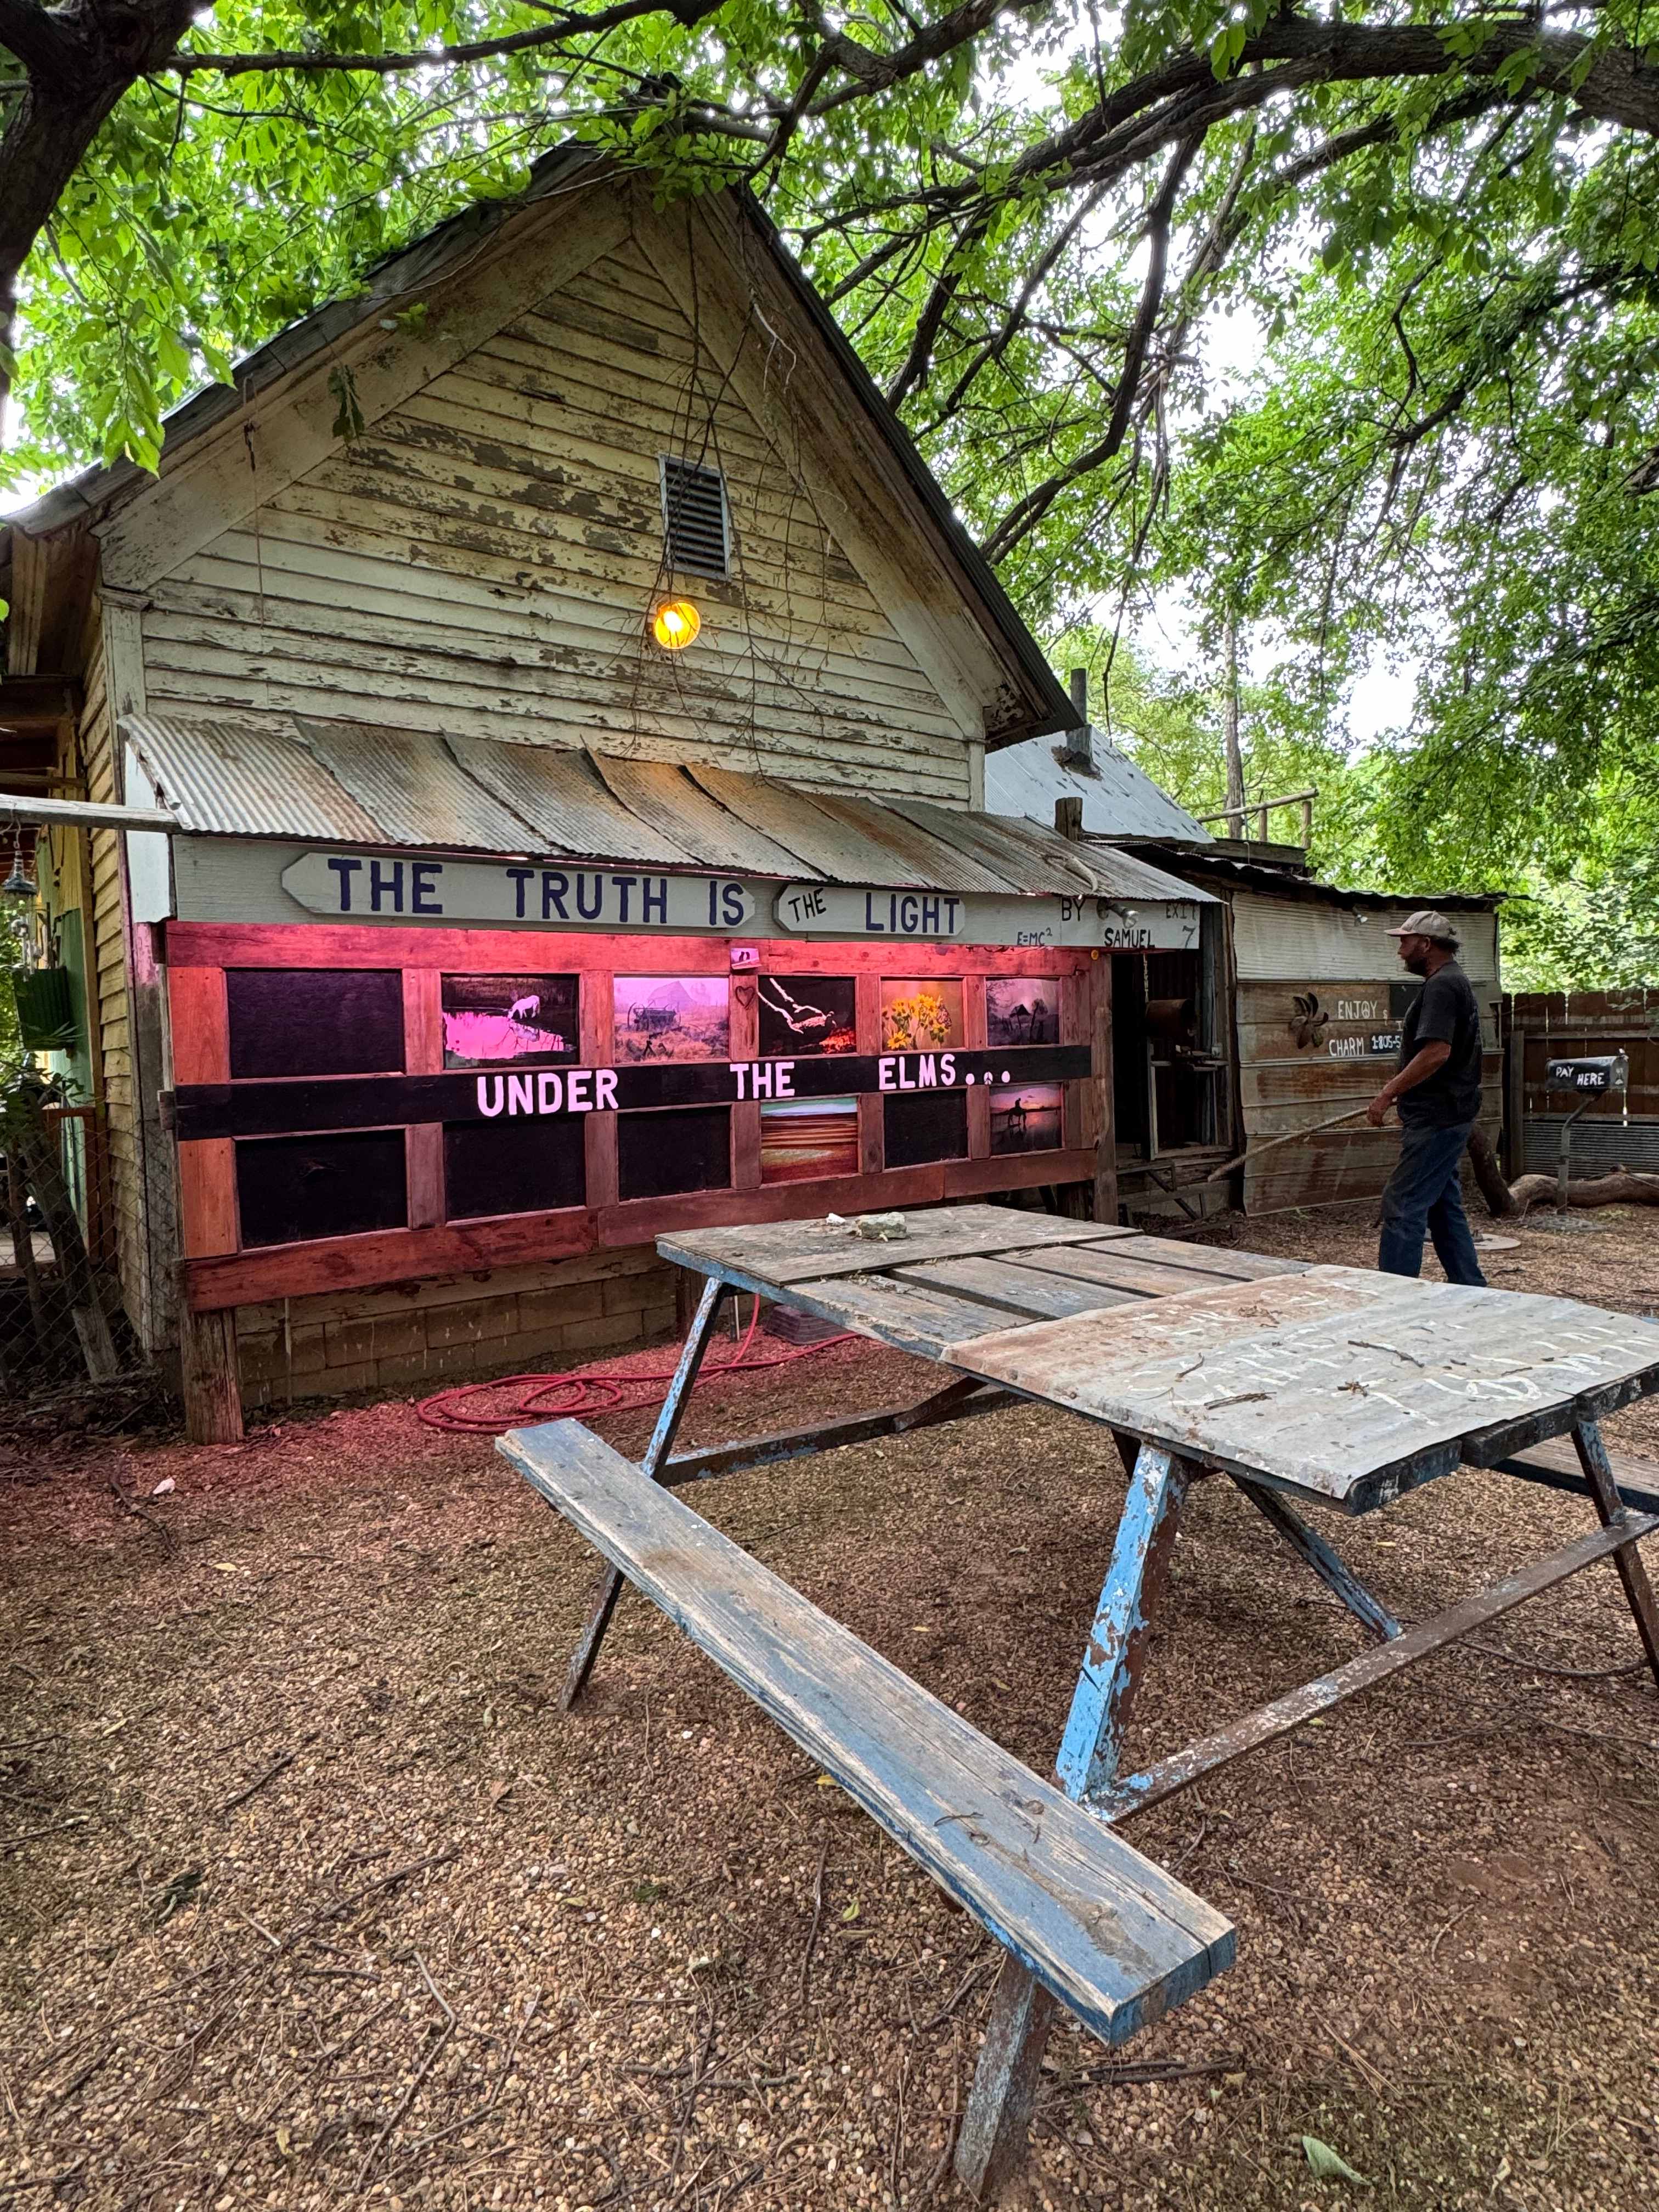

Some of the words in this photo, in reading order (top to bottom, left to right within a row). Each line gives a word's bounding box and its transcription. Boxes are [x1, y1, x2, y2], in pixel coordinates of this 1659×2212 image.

[328, 859, 443, 914] THE
[506, 868, 667, 924] TRUTH
[709, 881, 744, 926] IS
[786, 888, 827, 923] THE
[865, 891, 960, 934] LIGHT
[1062, 897, 1085, 921] BY
[1166, 903, 1197, 921] EXIT
[1104, 927, 1155, 949] SAMUEL
[1182, 926, 1196, 949] 7
[1338, 1000, 1378, 1019] ENJOY
[1329, 1037, 1364, 1057] CHARM
[1556, 1066, 1574, 1077] PAY
[1577, 1073, 1605, 1086] HERE
[477, 1069, 619, 1117] UNDER
[730, 1062, 795, 1099] THE
